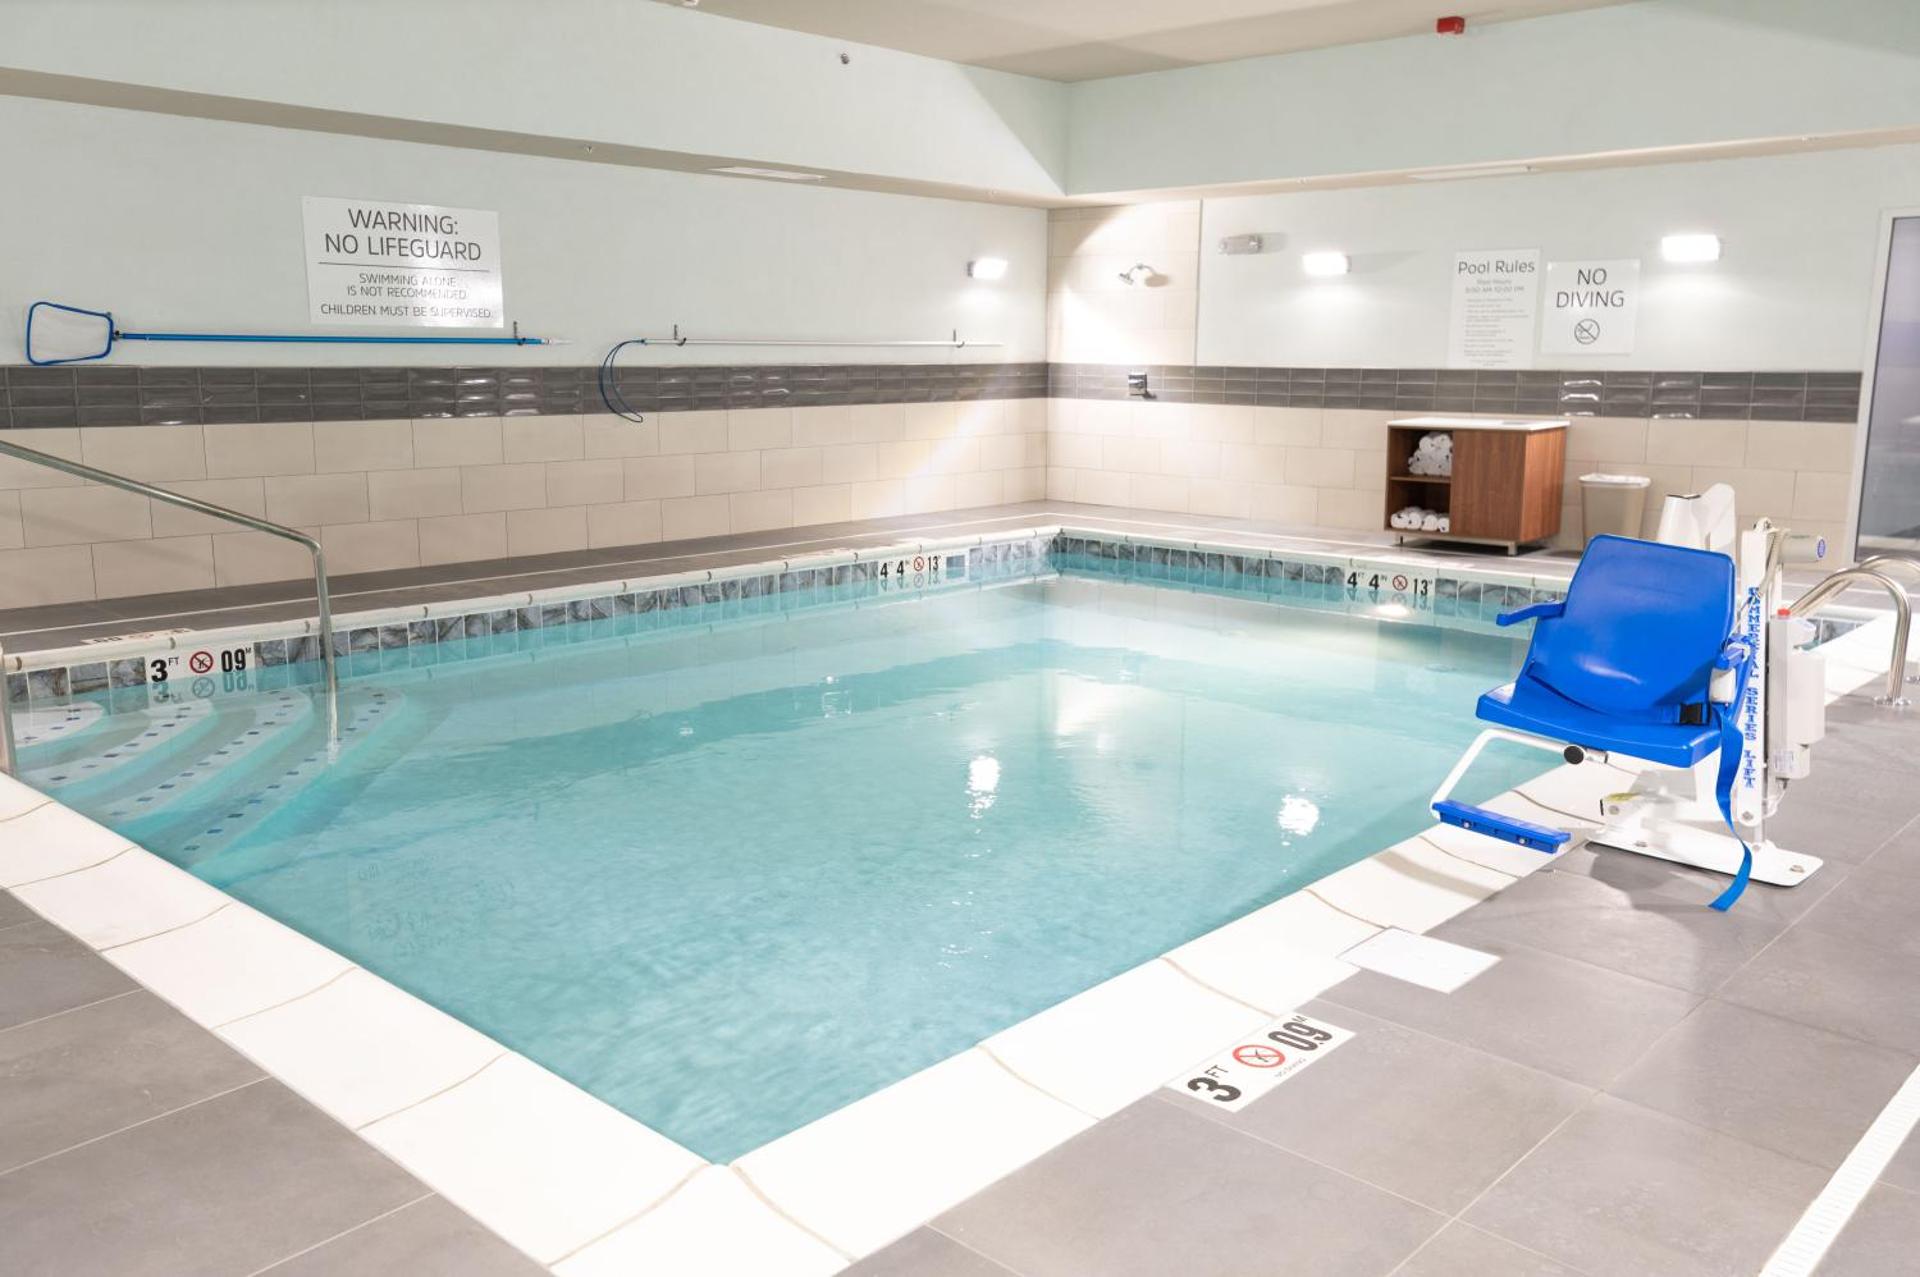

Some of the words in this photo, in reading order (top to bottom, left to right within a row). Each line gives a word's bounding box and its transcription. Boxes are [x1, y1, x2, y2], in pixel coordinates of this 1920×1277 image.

[348, 208, 459, 235] WARNING:
[325, 233, 358, 255] NO
[368, 236, 481, 261] LIFEGUARD
[1458, 261, 1491, 276] Pool
[1495, 260, 1536, 274] Rules
[1577, 268, 1608, 286] NO
[359, 273, 418, 286] SWIMMING
[422, 275, 456, 288] ALONE
[347, 285, 357, 297] IS
[360, 286, 383, 297] NOT
[1556, 290, 1625, 308] DIVING
[320, 303, 376, 316] CHILDREN
[380, 305, 409, 317] MUST
[413, 306, 428, 317] BE
[880, 562, 888, 578] 4
[897, 560, 904, 576] 4
[1347, 572, 1357, 588] 4
[1369, 574, 1379, 590] 4
[151, 659, 168, 682] 3
[1744, 687, 1758, 740] SERIES
[1743, 750, 1756, 788] LIFT
[1187, 1077, 1242, 1102] 3
